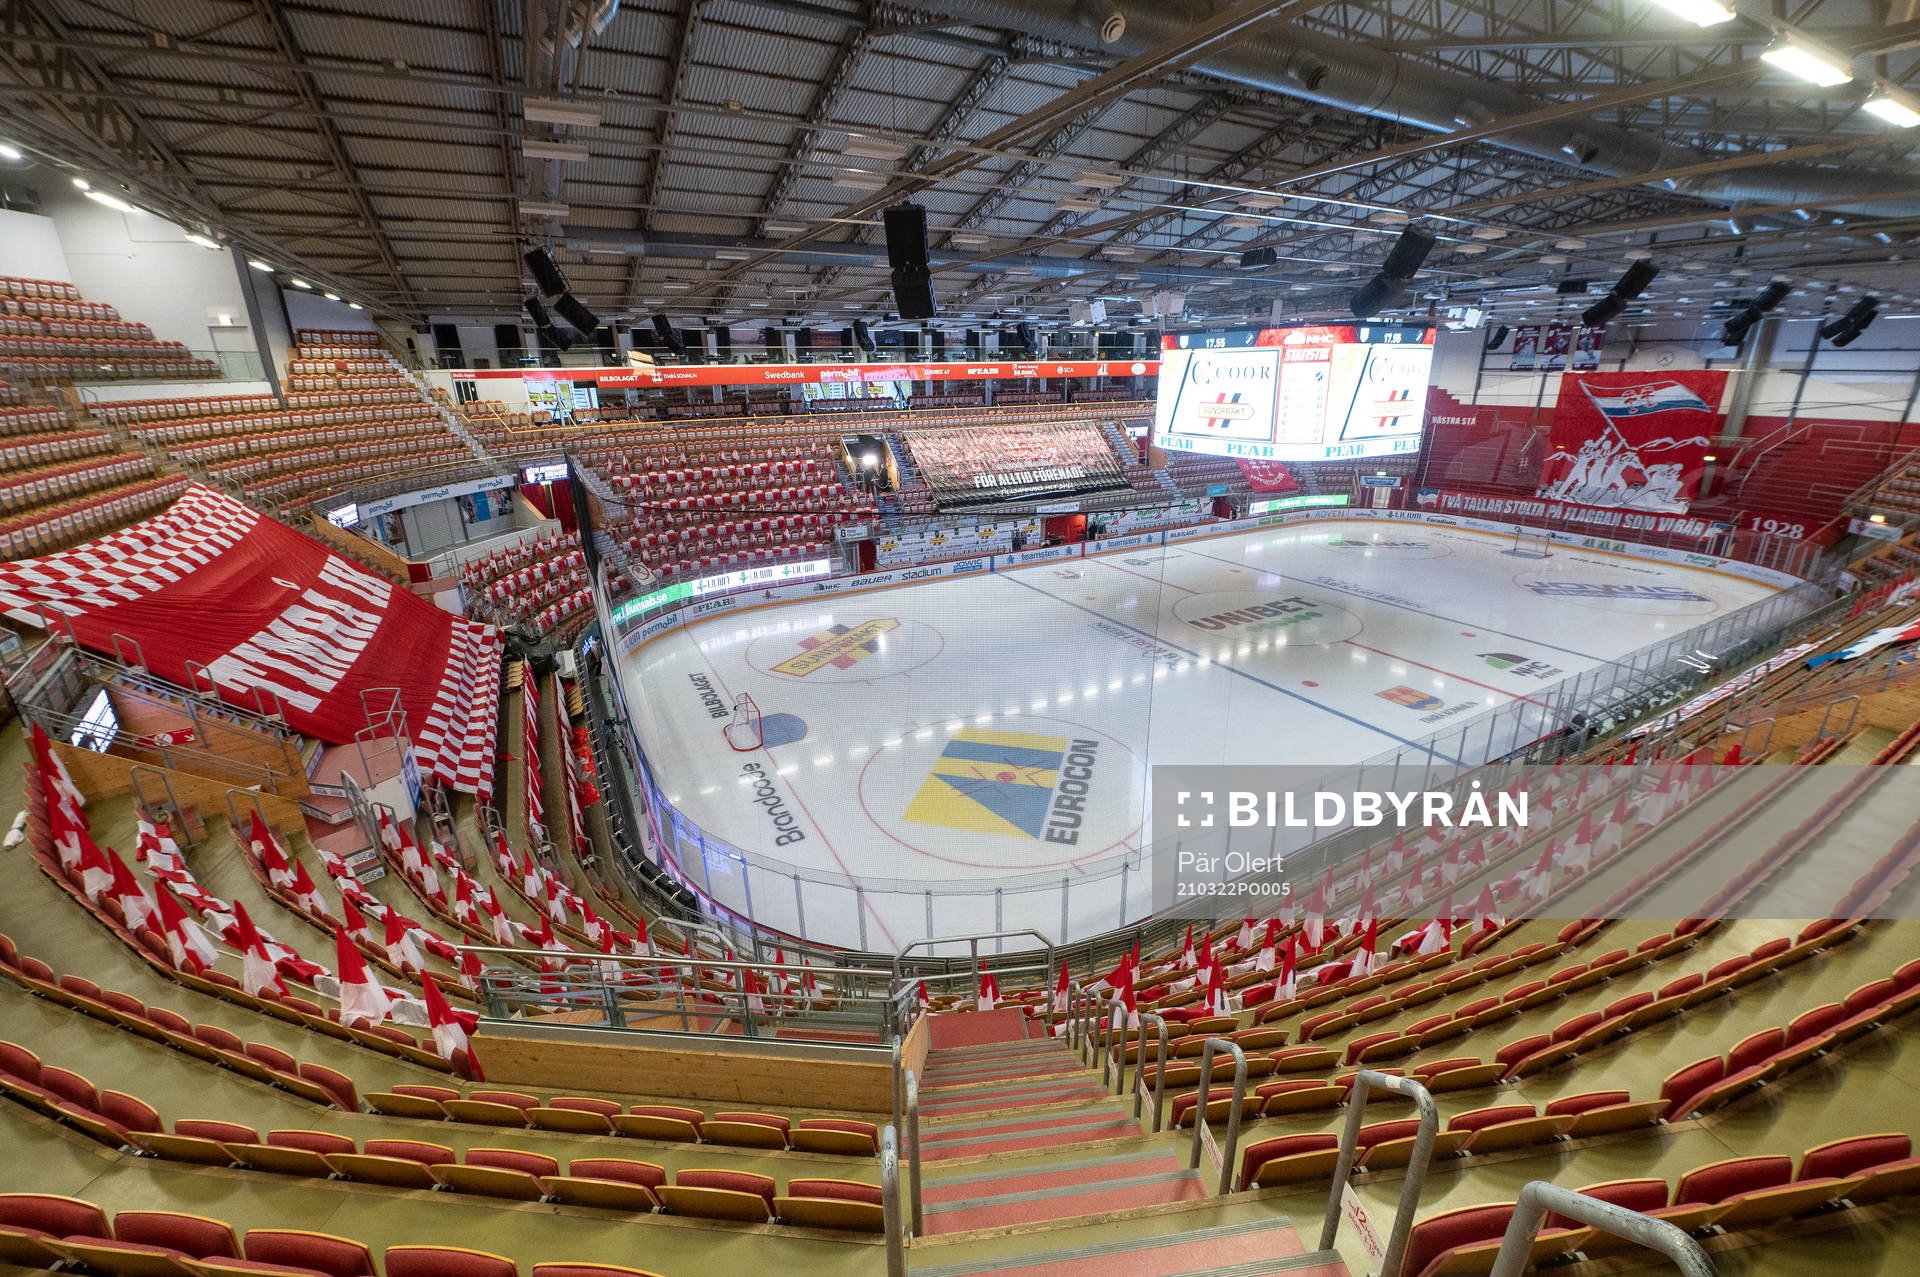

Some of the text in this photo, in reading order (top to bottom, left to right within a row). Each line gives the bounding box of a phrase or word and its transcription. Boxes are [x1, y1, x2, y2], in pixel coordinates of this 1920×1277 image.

[765, 371, 805, 379] Swedbank
[820, 368, 859, 379] permobil
[1432, 416, 1460, 424] VÄSTRA
[1160, 436, 1193, 449] PEAB
[1226, 443, 1274, 457] PEAB
[1324, 444, 1364, 457] PEAB
[478, 479, 503, 490] permobil
[974, 466, 1085, 488] FÖR ALLTID FÖRENADE
[421, 488, 449, 501] permobil
[368, 500, 393, 515] permobil
[1441, 493, 1706, 537] TVÅ TALLAR STOLTA PÅ FLAGGAN SOM VI BÄR
[1751, 516, 1804, 539] 1928
[1107, 537, 1142, 547] teamsters
[1021, 549, 1060, 561] teamsters
[318, 554, 392, 608] IK
[901, 567, 942, 581] stadium
[698, 598, 731, 613] PEAB
[1188, 597, 1318, 630] UNIBET
[642, 613, 678, 640] permobil
[790, 623, 882, 670] SUNDFRAKT
[1509, 661, 1551, 677] NHC
[688, 672, 729, 719] BILBOLAGET
[1045, 738, 1099, 846] EUROCON
